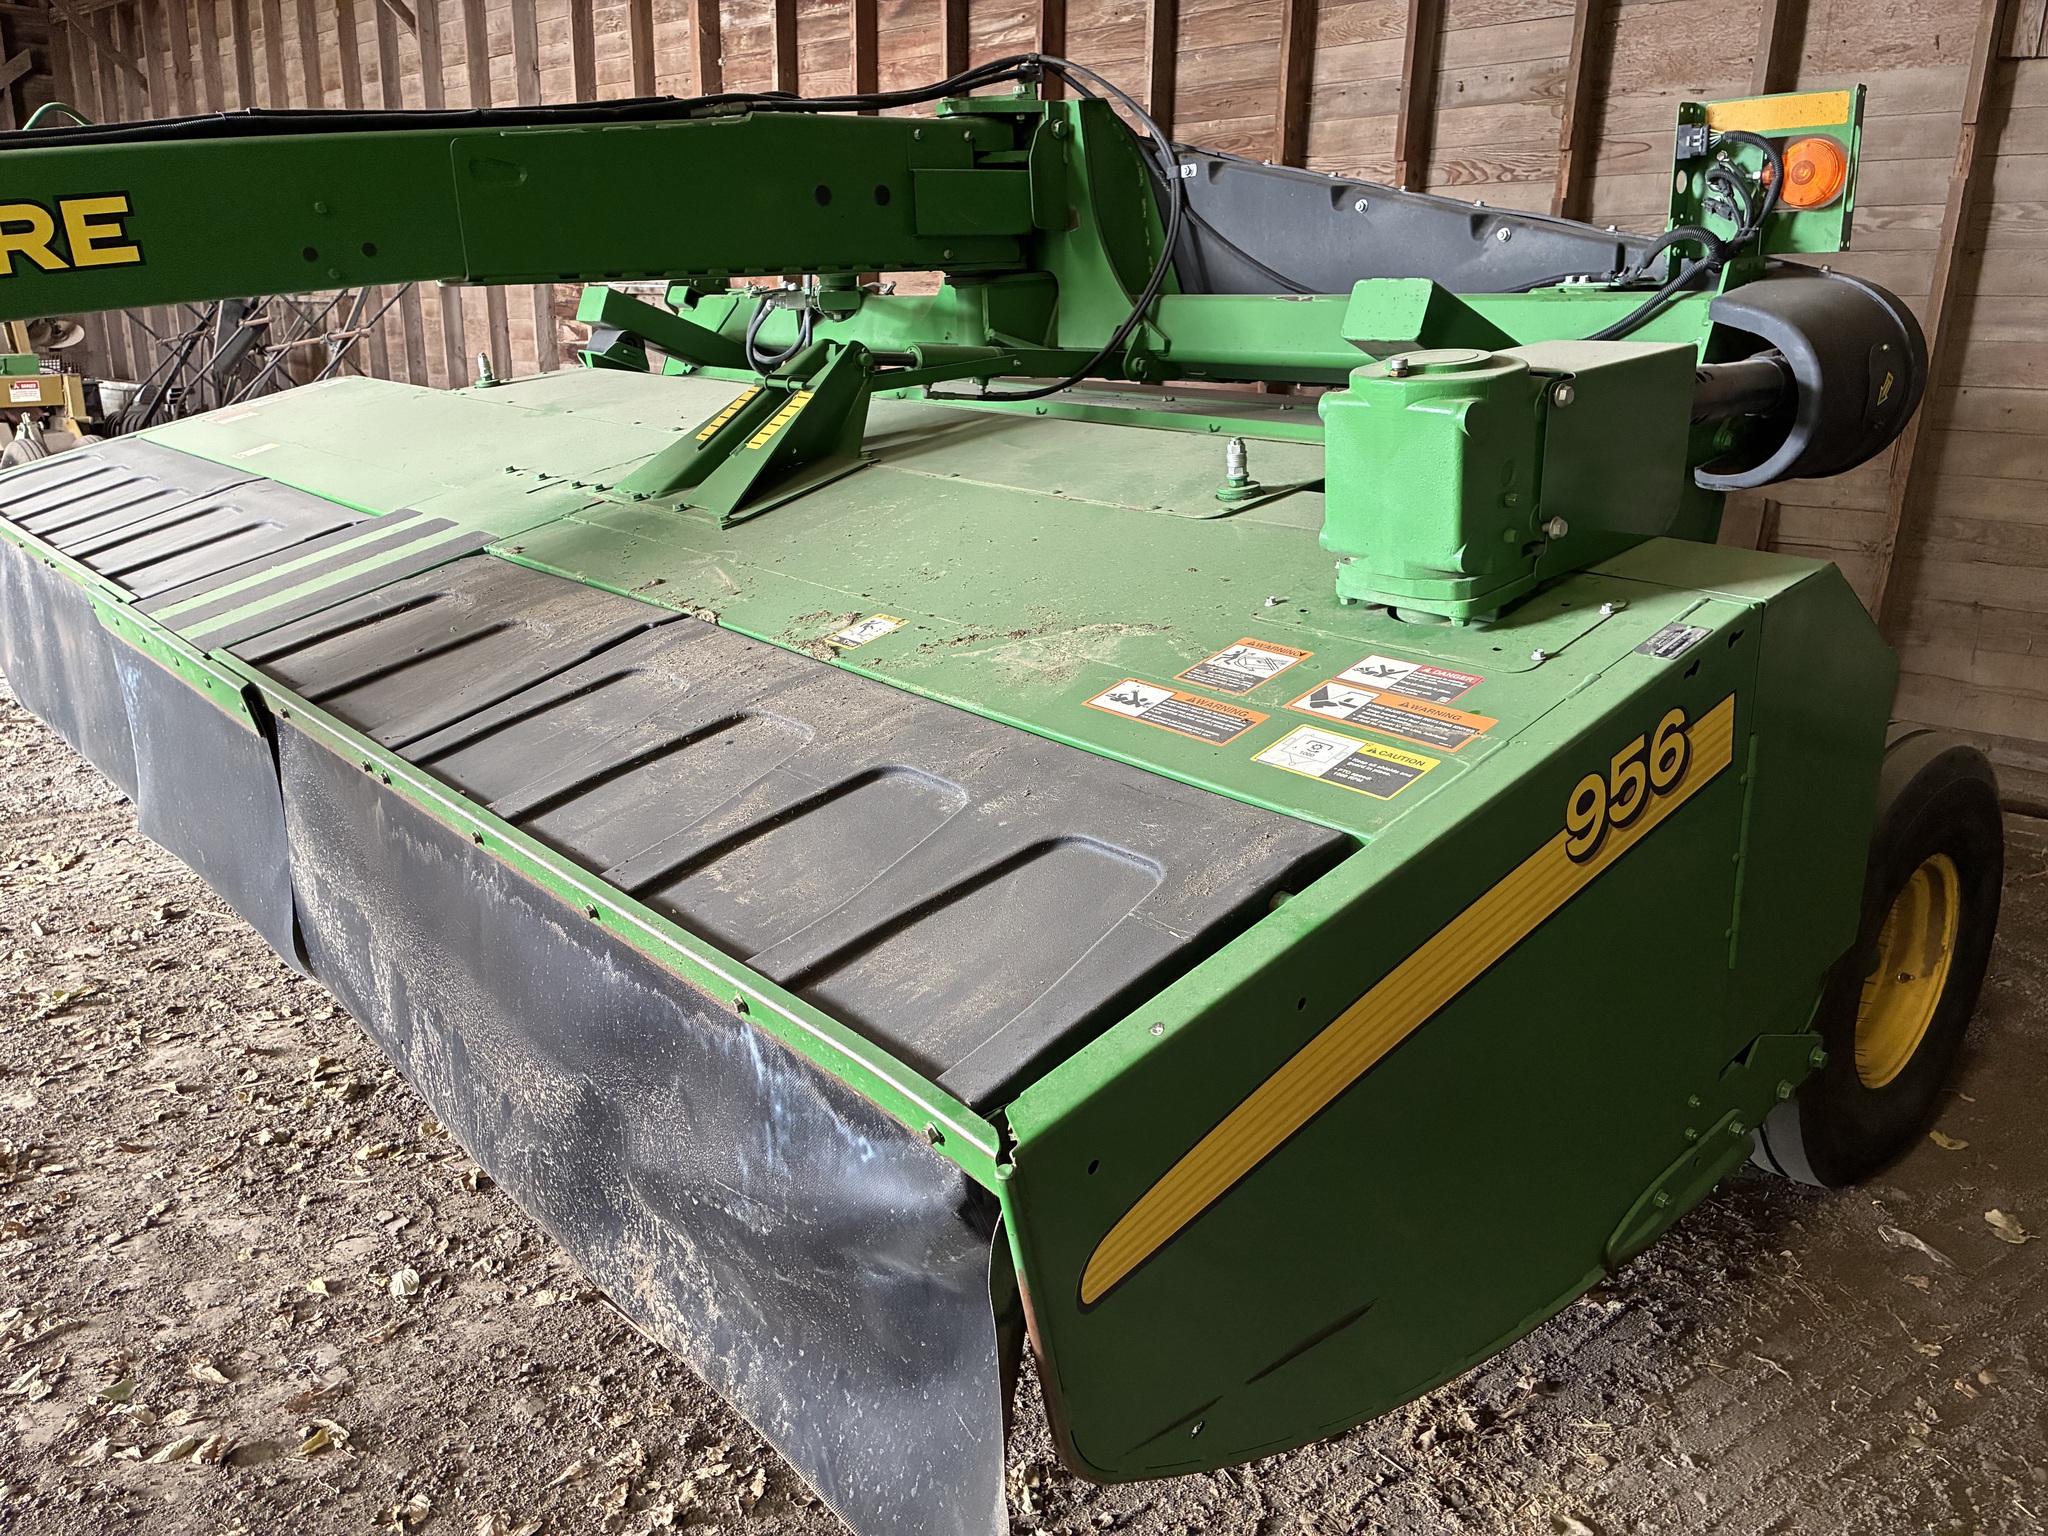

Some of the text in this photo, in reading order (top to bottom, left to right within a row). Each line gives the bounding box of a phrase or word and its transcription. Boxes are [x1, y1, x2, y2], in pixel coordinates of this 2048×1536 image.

[1256, 642, 1303, 656] WARNING
[1433, 670, 1474, 682] DANGER
[1194, 698, 1250, 717] WARNING
[1410, 704, 1462, 721] WARNING
[1300, 750, 1315, 758] 1000
[1379, 750, 1426, 767] CAUTION
[1565, 707, 1690, 862] 956
